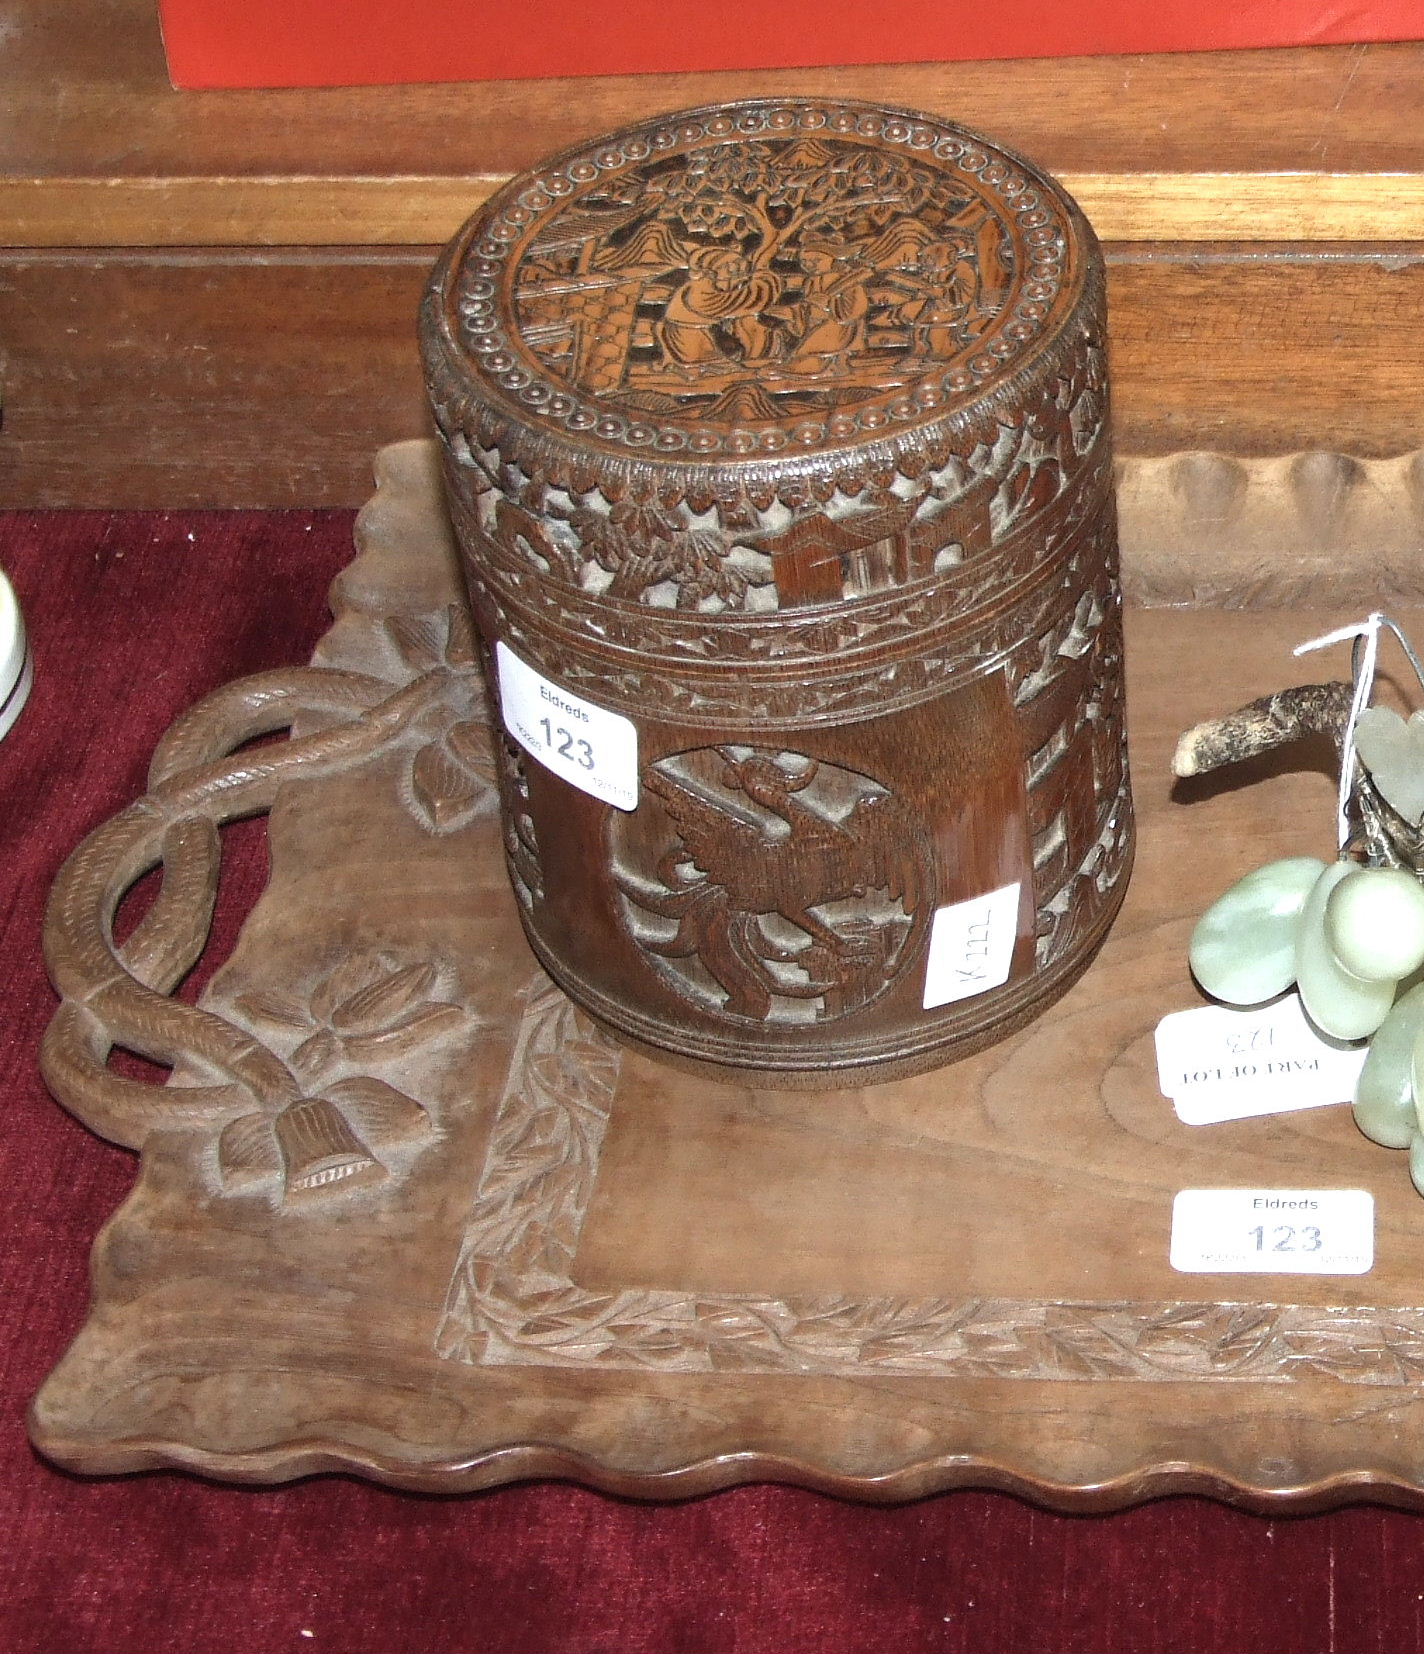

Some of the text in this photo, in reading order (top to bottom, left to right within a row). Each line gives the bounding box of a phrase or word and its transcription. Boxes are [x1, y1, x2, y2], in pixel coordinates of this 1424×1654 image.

[540, 685, 589, 722] Eldreds
[540, 717, 595, 770] 123
[955, 909, 991, 982] K222
[1225, 1027, 1274, 1053] 123
[1182, 1059, 1320, 1084] PART OF LOT
[1253, 1198, 1319, 1210] Eldreds
[1248, 1225, 1323, 1252] 123
